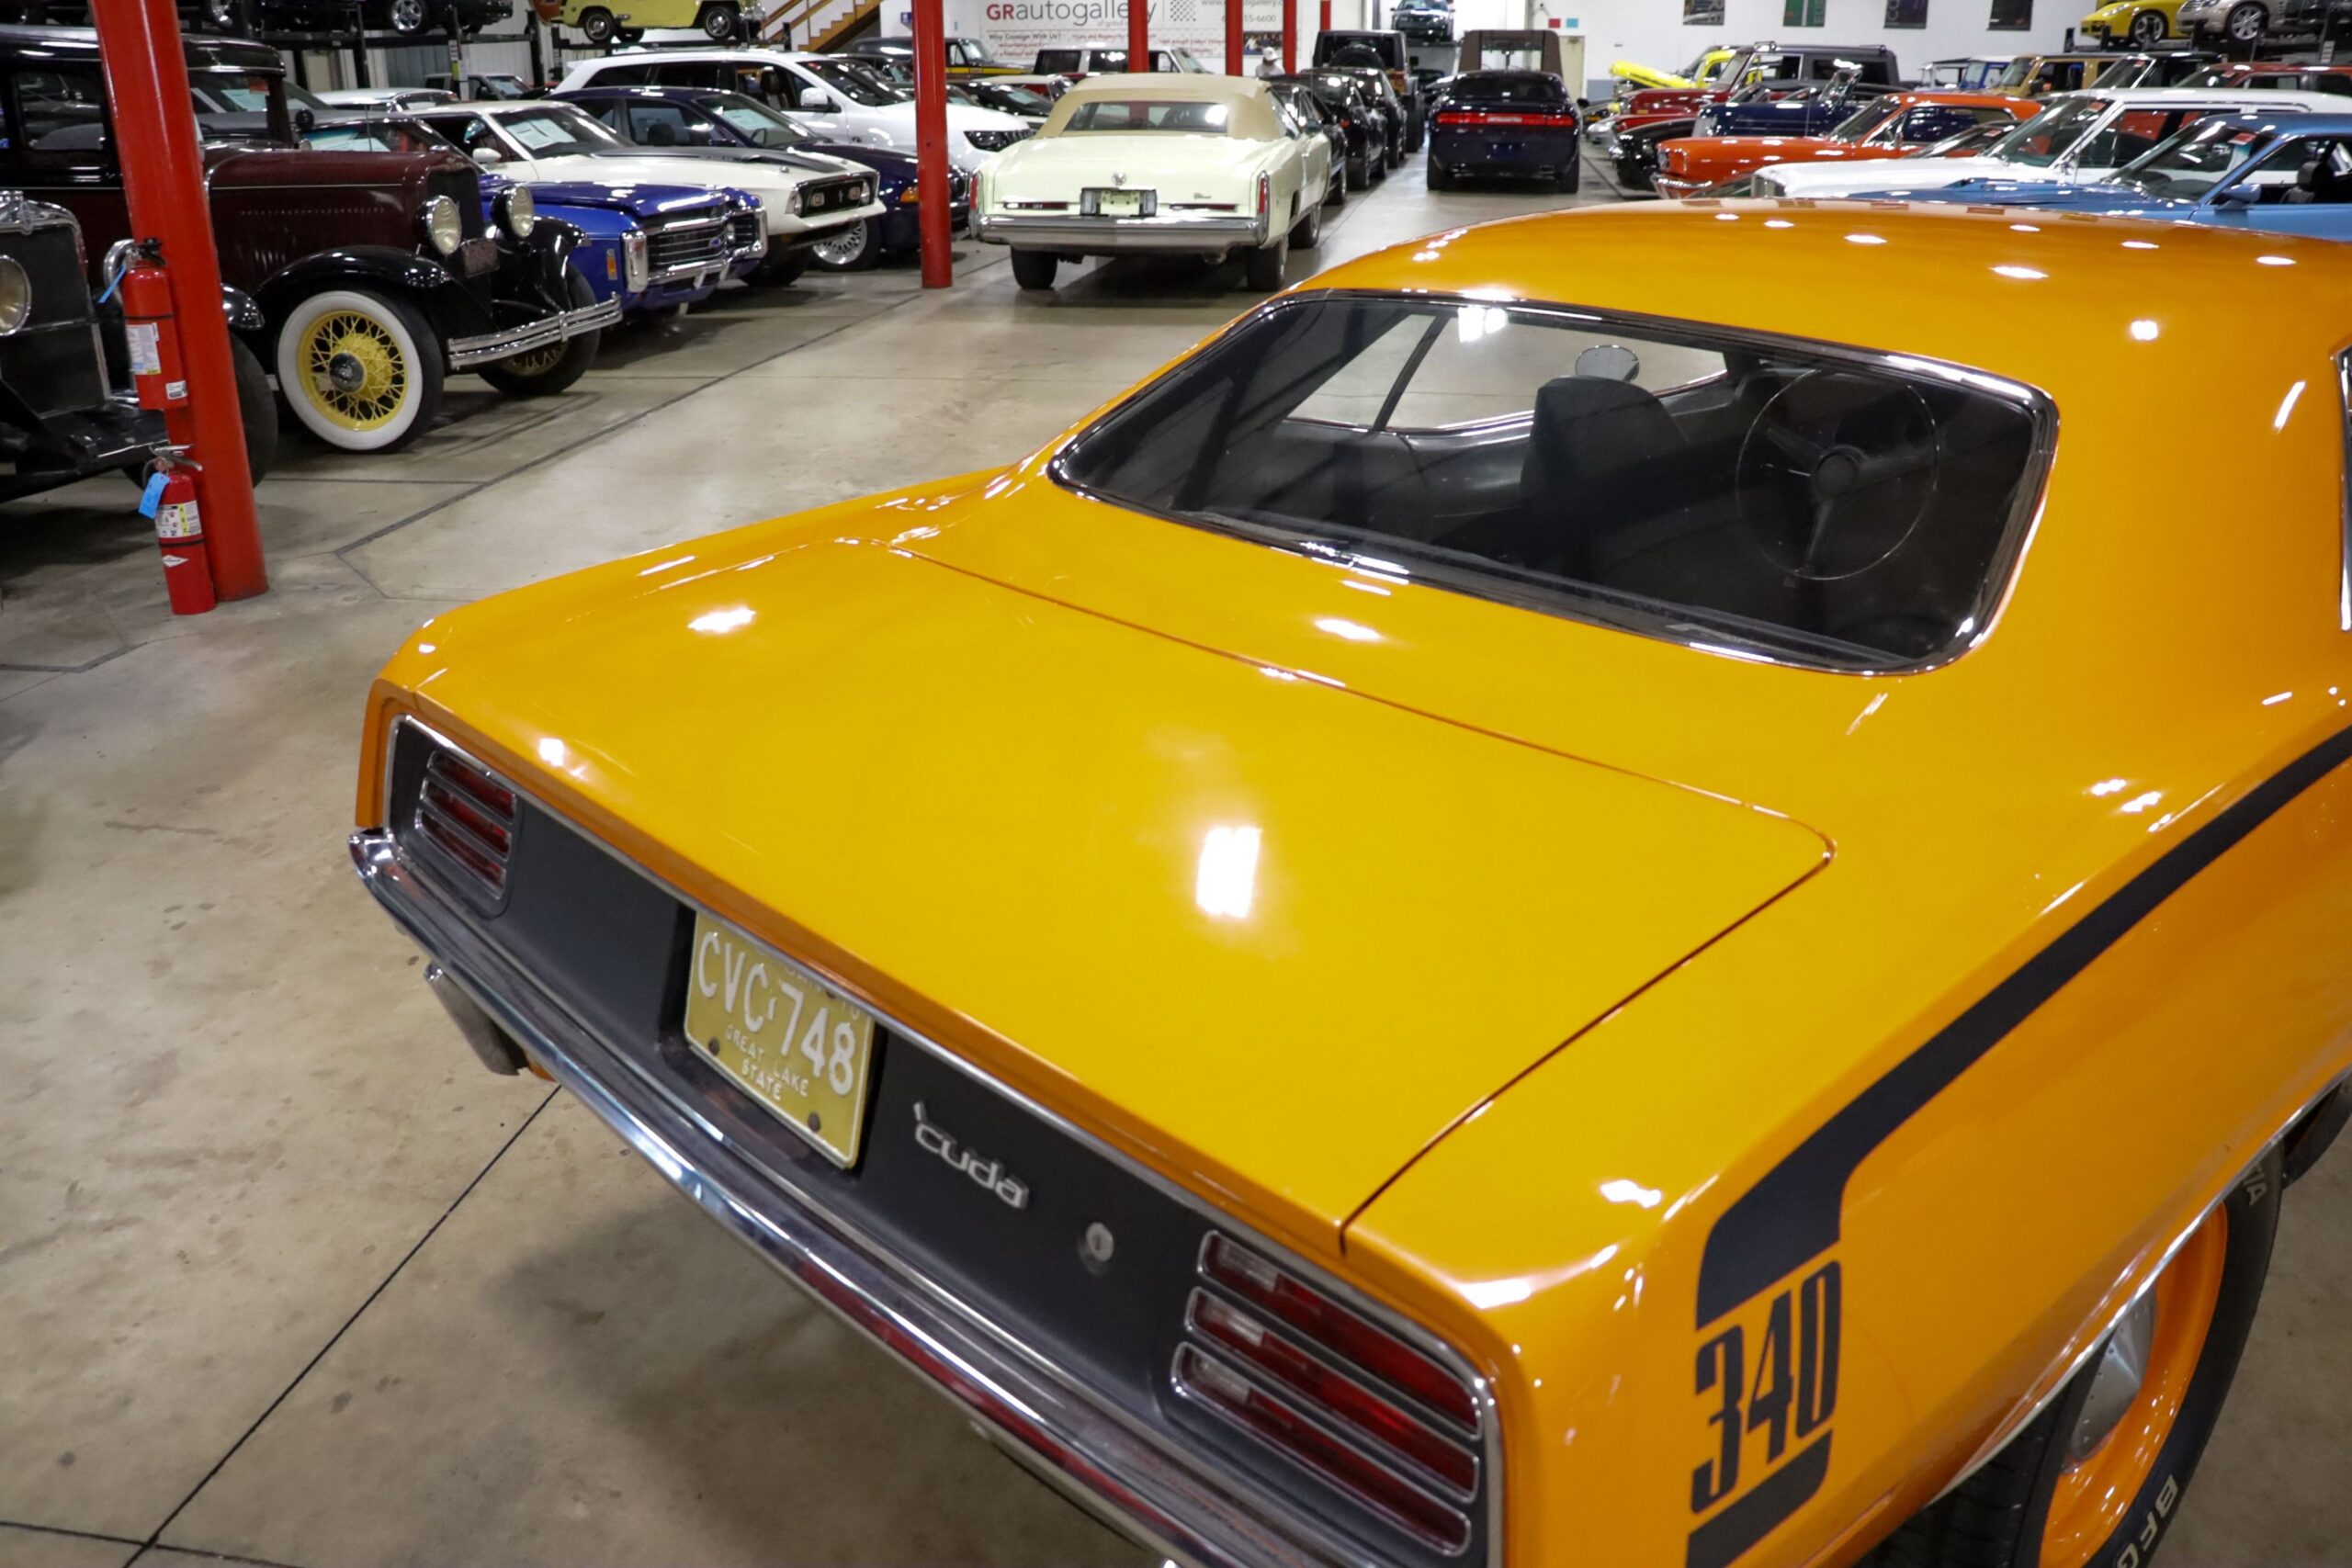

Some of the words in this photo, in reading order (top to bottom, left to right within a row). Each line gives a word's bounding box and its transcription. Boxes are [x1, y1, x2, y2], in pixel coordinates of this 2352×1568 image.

[987, 0, 1157, 27] GRautogalley
[725, 1022, 764, 1062] GREAT
[773, 1059, 809, 1098] LAKE
[741, 1058, 784, 1102] STATE
[1690, 1259, 1841, 1515] 340
